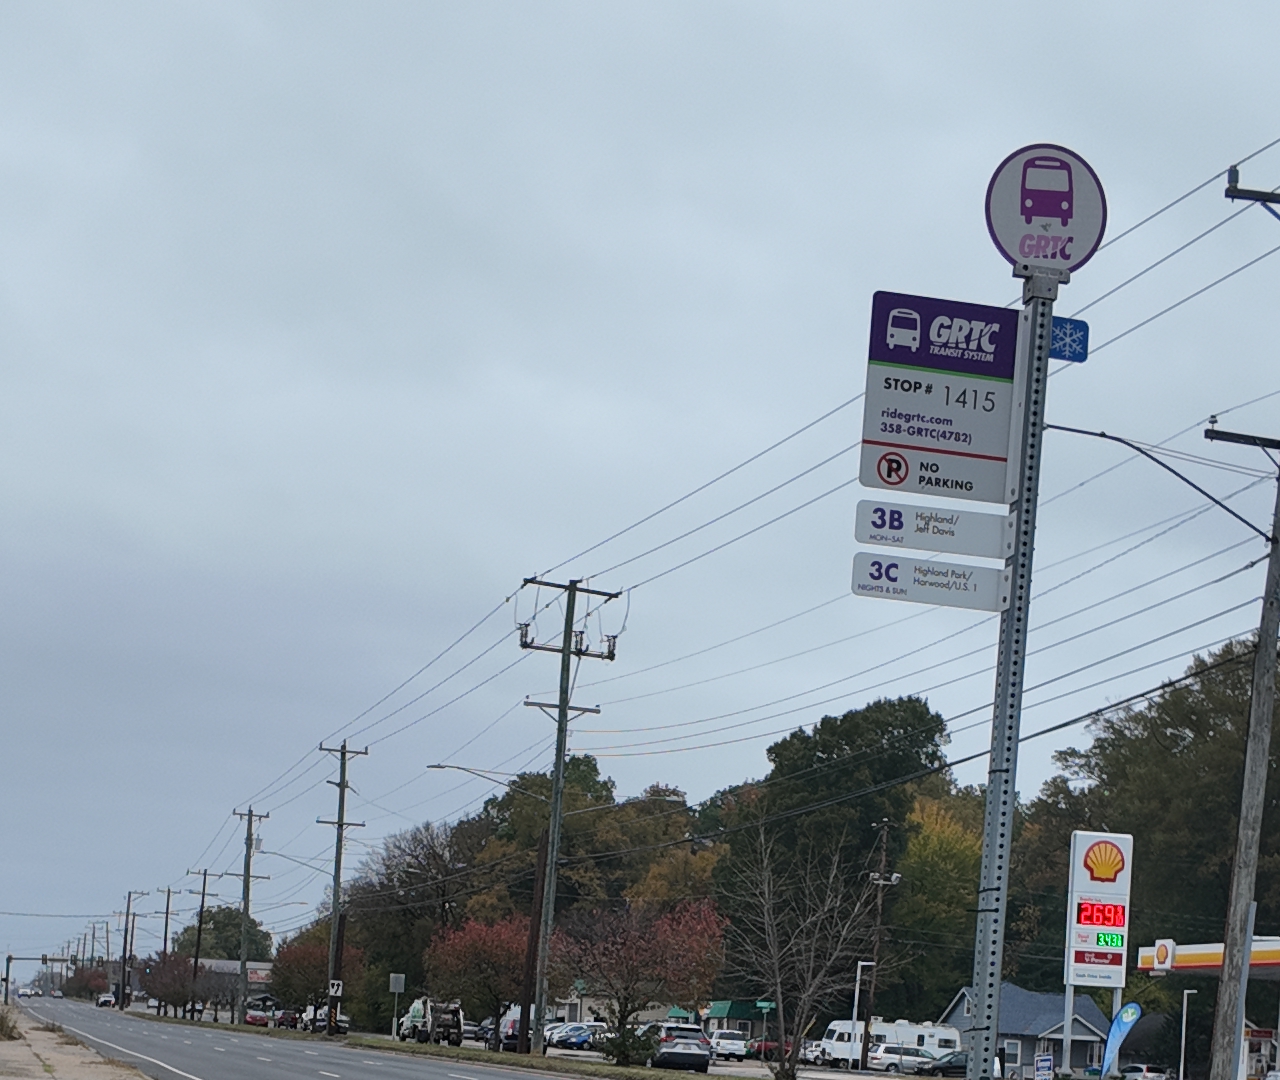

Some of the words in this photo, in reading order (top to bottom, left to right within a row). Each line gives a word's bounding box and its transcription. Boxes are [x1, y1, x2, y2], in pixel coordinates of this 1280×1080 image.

[1019, 234, 1074, 260] GRTC
[929, 315, 1000, 352] GRTC
[929, 345, 963, 358] TRANSIT
[963, 350, 994, 362] SYSTEM
[883, 377, 922, 393] STOP
[943, 386, 996, 412] 1415
[881, 408, 953, 426] ridegrtc.com
[880, 422, 972, 445] 358-GRTC(4782)
[919, 461, 940, 473] NO
[918, 476, 974, 491] PARKING
[871, 507, 904, 530] 3B
[915, 511, 960, 526] Highland/
[914, 522, 930, 533] Jeff
[932, 525, 955, 536] Davis
[869, 534, 904, 543] MON-SAT
[868, 560, 899, 582] 3C
[913, 565, 949, 577] Highland
[950, 569, 973, 581] Park/
[857, 583, 884, 593] NIGHTS
[892, 587, 908, 595] SUN
